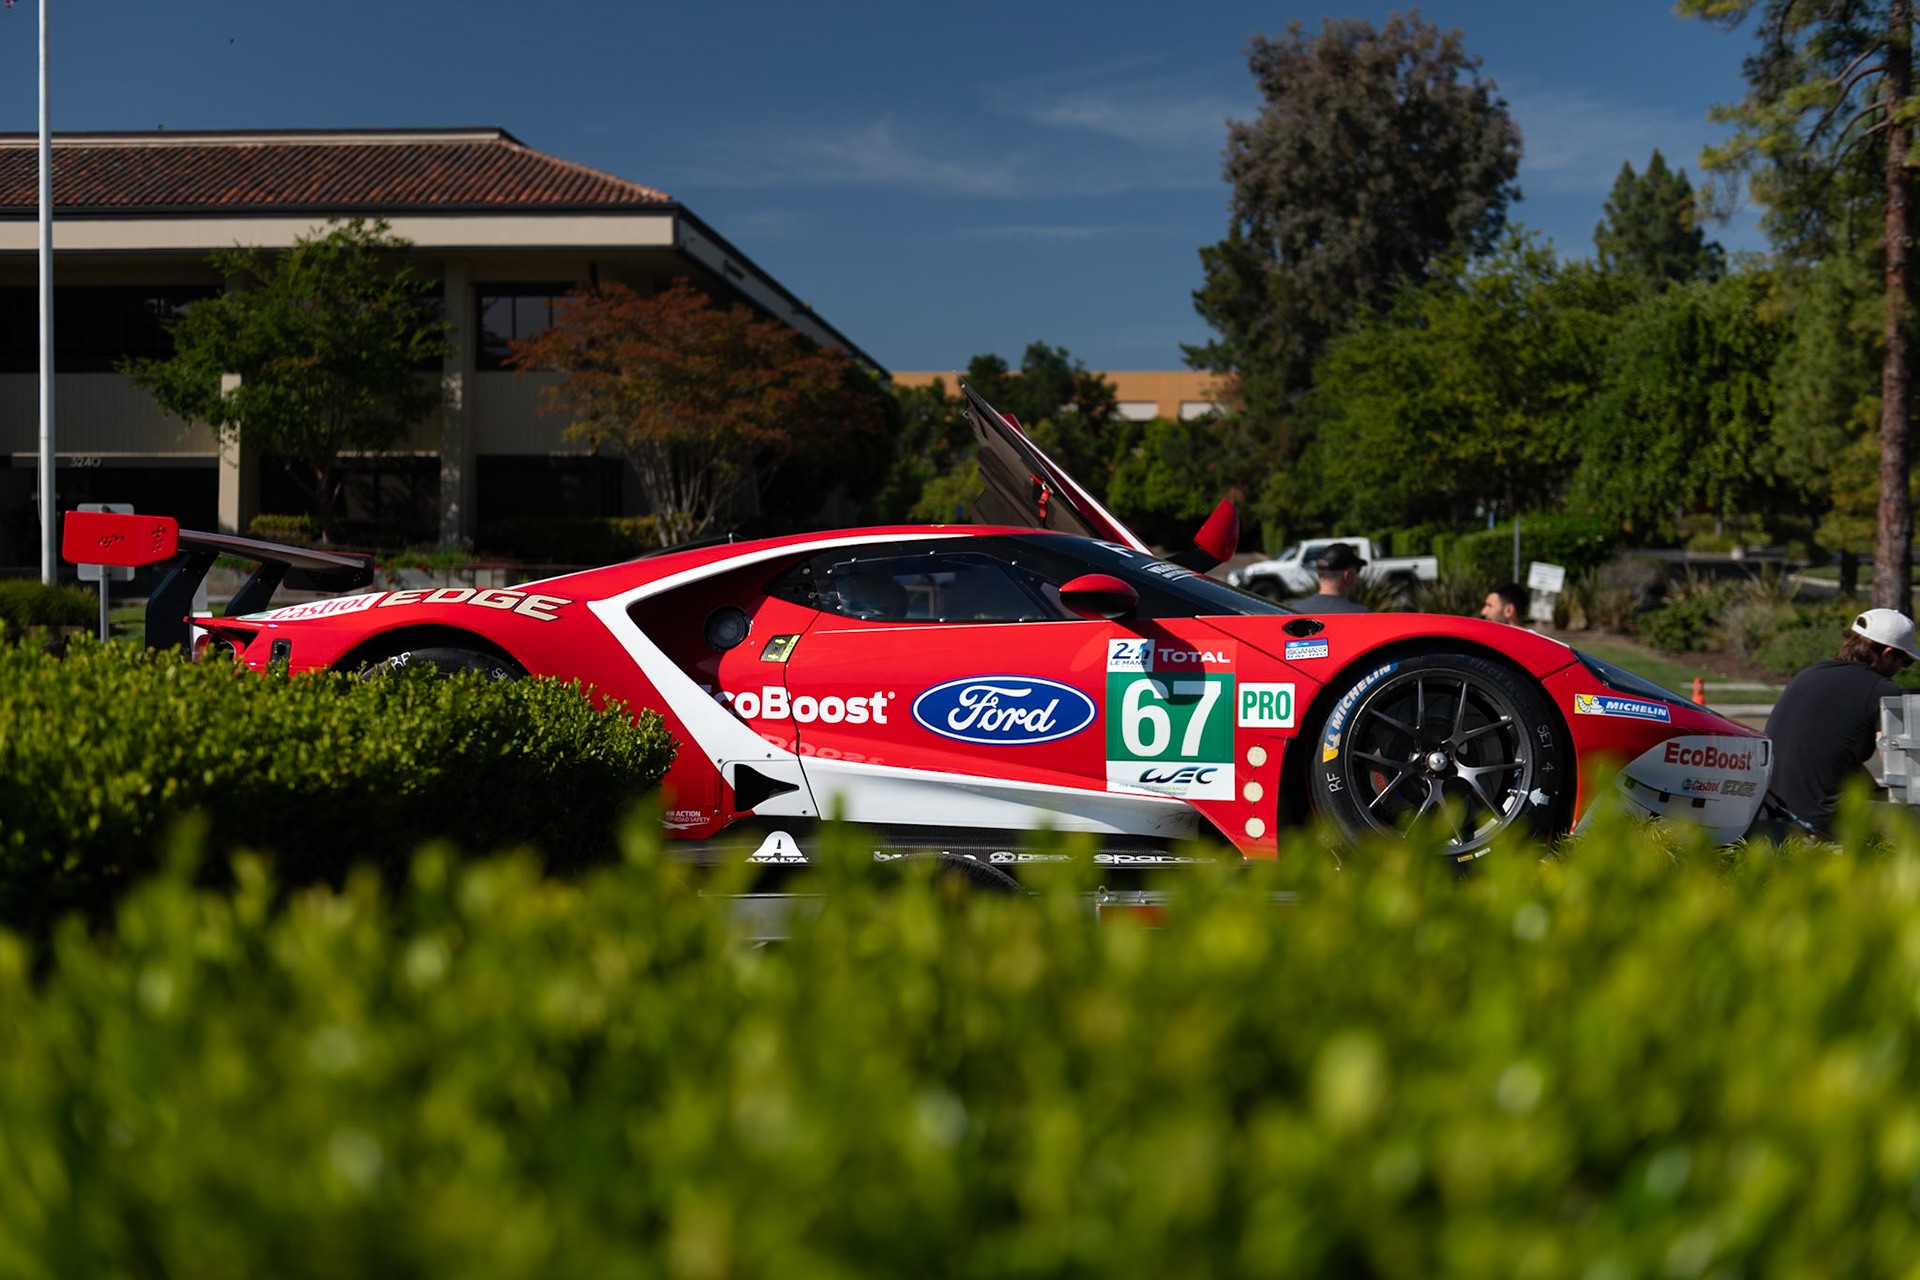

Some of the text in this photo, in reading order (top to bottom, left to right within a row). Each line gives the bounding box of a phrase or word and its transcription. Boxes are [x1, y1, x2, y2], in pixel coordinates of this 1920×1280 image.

[272, 588, 574, 621] Castrol EDGE
[1158, 648, 1231, 663] TOTAL
[948, 685, 1060, 732] Ford
[1242, 690, 1291, 721] PRO
[1331, 664, 1391, 730] MICHELIN
[1606, 701, 1667, 717] MICHELIN
[1121, 678, 1221, 757] 67
[1664, 742, 1752, 771] EcoBoost
[1138, 766, 1218, 785] WEC
[1327, 772, 1343, 792] RF
[1691, 778, 1758, 797] Castrol EDGE
[676, 810, 701, 818] ACTION
